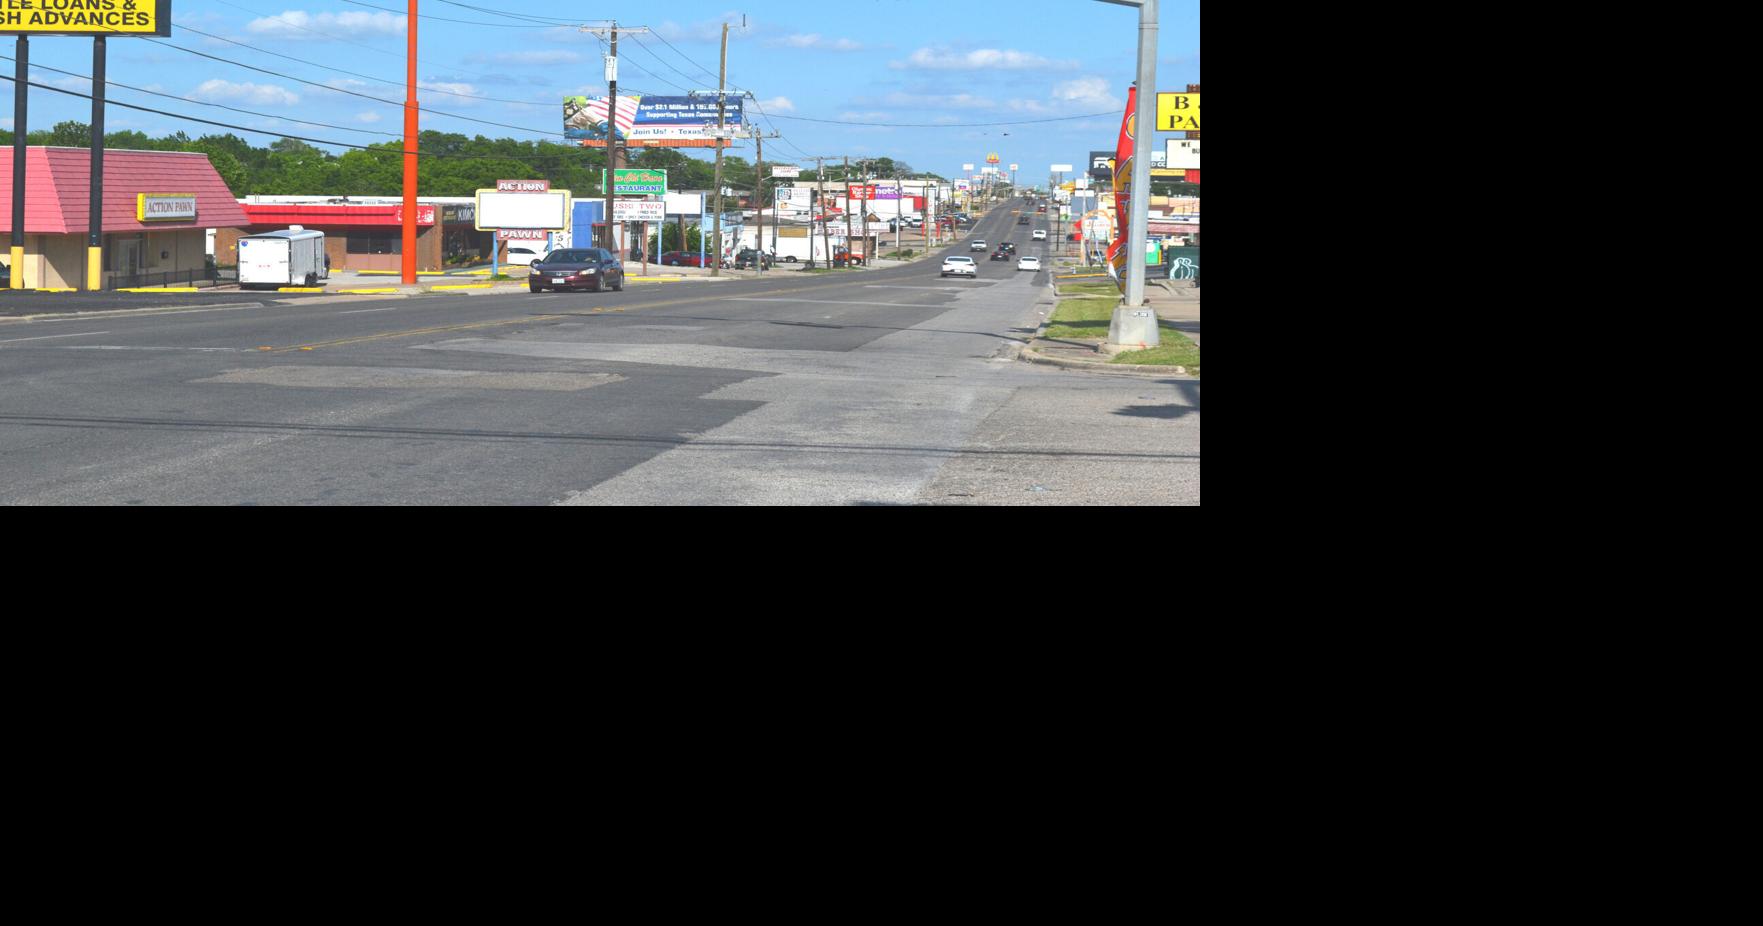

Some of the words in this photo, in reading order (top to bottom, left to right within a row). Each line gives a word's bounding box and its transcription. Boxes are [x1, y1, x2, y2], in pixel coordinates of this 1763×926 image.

[0, 0, 33, 10] LE
[41, 0, 115, 10] LOANS
[122, 0, 137, 10] &
[29, 12, 150, 26] ADVANCES
[1174, 96, 1190, 110] B
[498, 183, 545, 191] ACTION
[147, 201, 174, 213] ACTION
[175, 201, 193, 212] PAWN
[500, 230, 543, 239] PAWN
